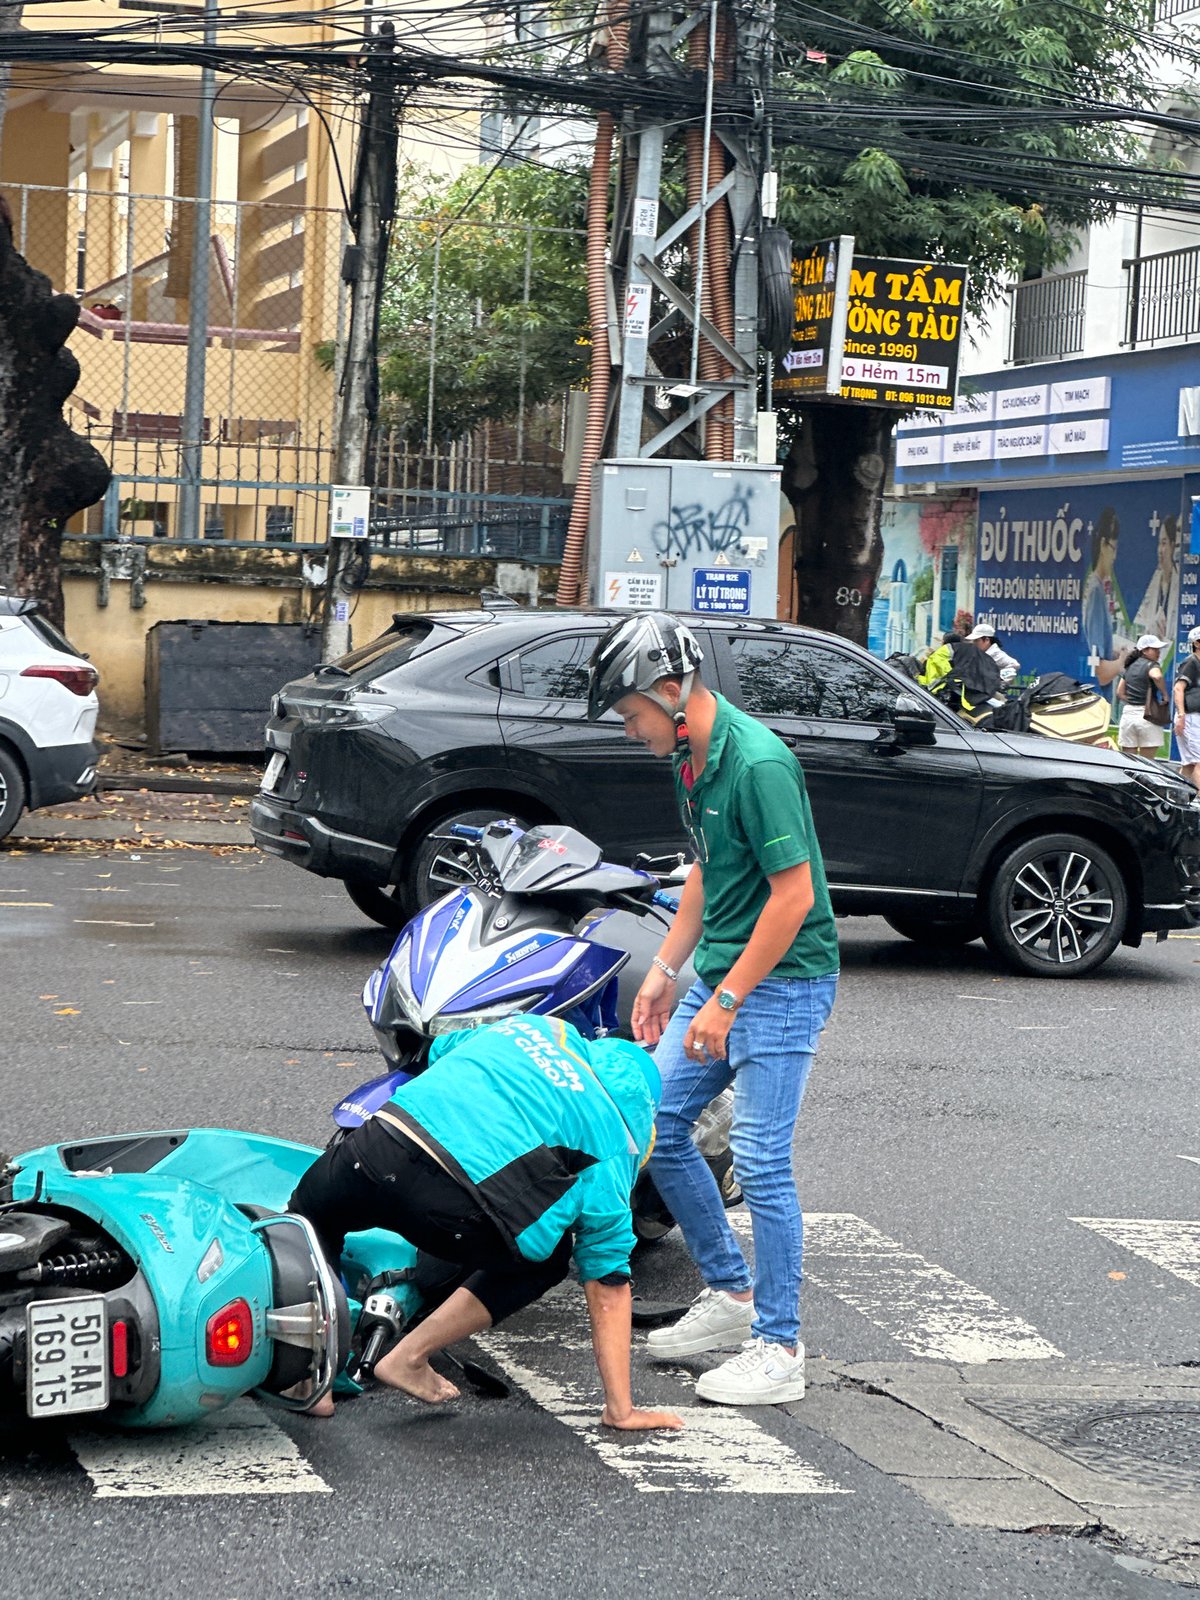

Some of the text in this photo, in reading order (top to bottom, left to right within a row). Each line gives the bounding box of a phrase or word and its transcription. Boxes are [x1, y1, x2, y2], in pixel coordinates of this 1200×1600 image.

[886, 266, 962, 306] TẤM
[846, 299, 958, 341] ỜNG TÀU
[879, 342, 918, 362] 1996)
[862, 363, 898, 380] Hẻm
[906, 368, 941, 384] 15m
[851, 387, 878, 400] TRỌNG
[886, 390, 898, 401] ĐT:
[899, 394, 914, 402] 096
[916, 394, 935, 404] 1913
[936, 396, 952, 406] 032
[980, 503, 1082, 563] ĐỦ THUỐC
[696, 584, 747, 602] LÝ TỰ TRỌNG
[835, 586, 862, 606] 80
[978, 574, 1081, 607] THEO ĐƠN BỆNH VIỆN
[997, 612, 1024, 636] LƯỢNG
[1026, 610, 1051, 634] CHÍNH
[34, 1314, 66, 1407] 169.15
[70, 1314, 102, 1396] 50-AA
